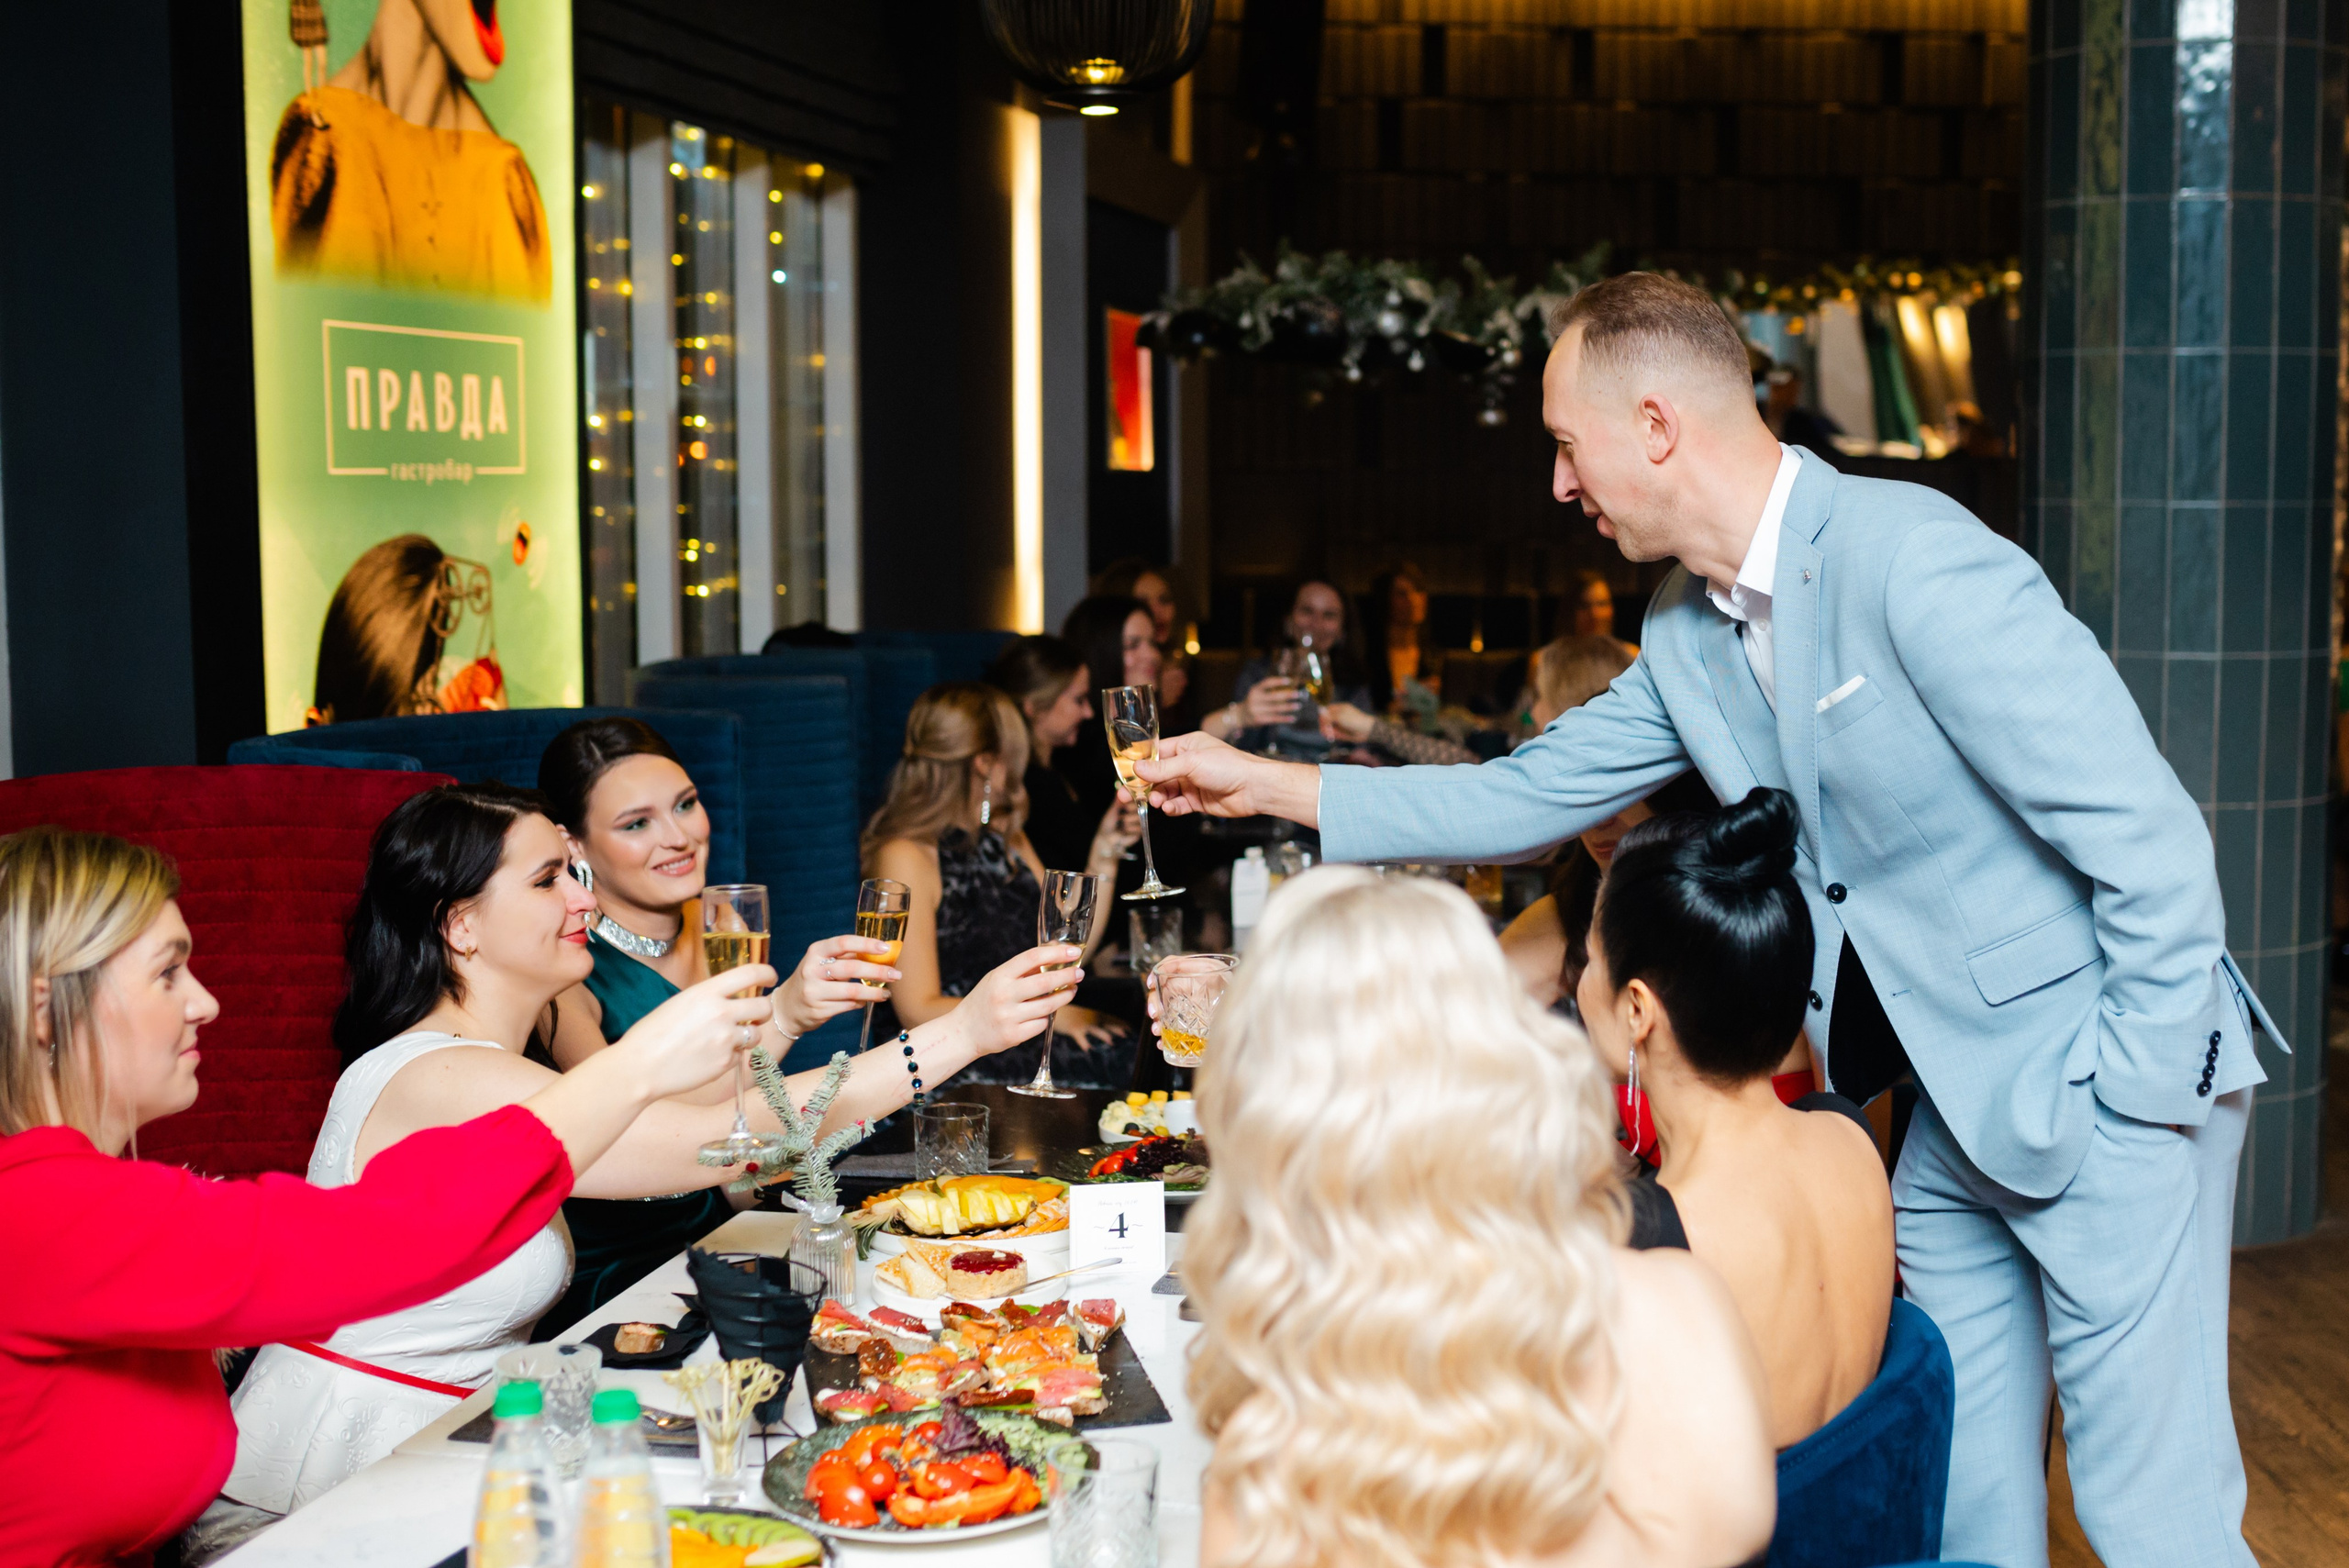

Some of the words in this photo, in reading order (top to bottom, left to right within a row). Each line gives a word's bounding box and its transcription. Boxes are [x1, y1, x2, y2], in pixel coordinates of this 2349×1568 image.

[346, 366, 508, 440] ПРАВДА
[391, 459, 473, 485] гастробар
[1108, 1211, 1130, 1239] 4
